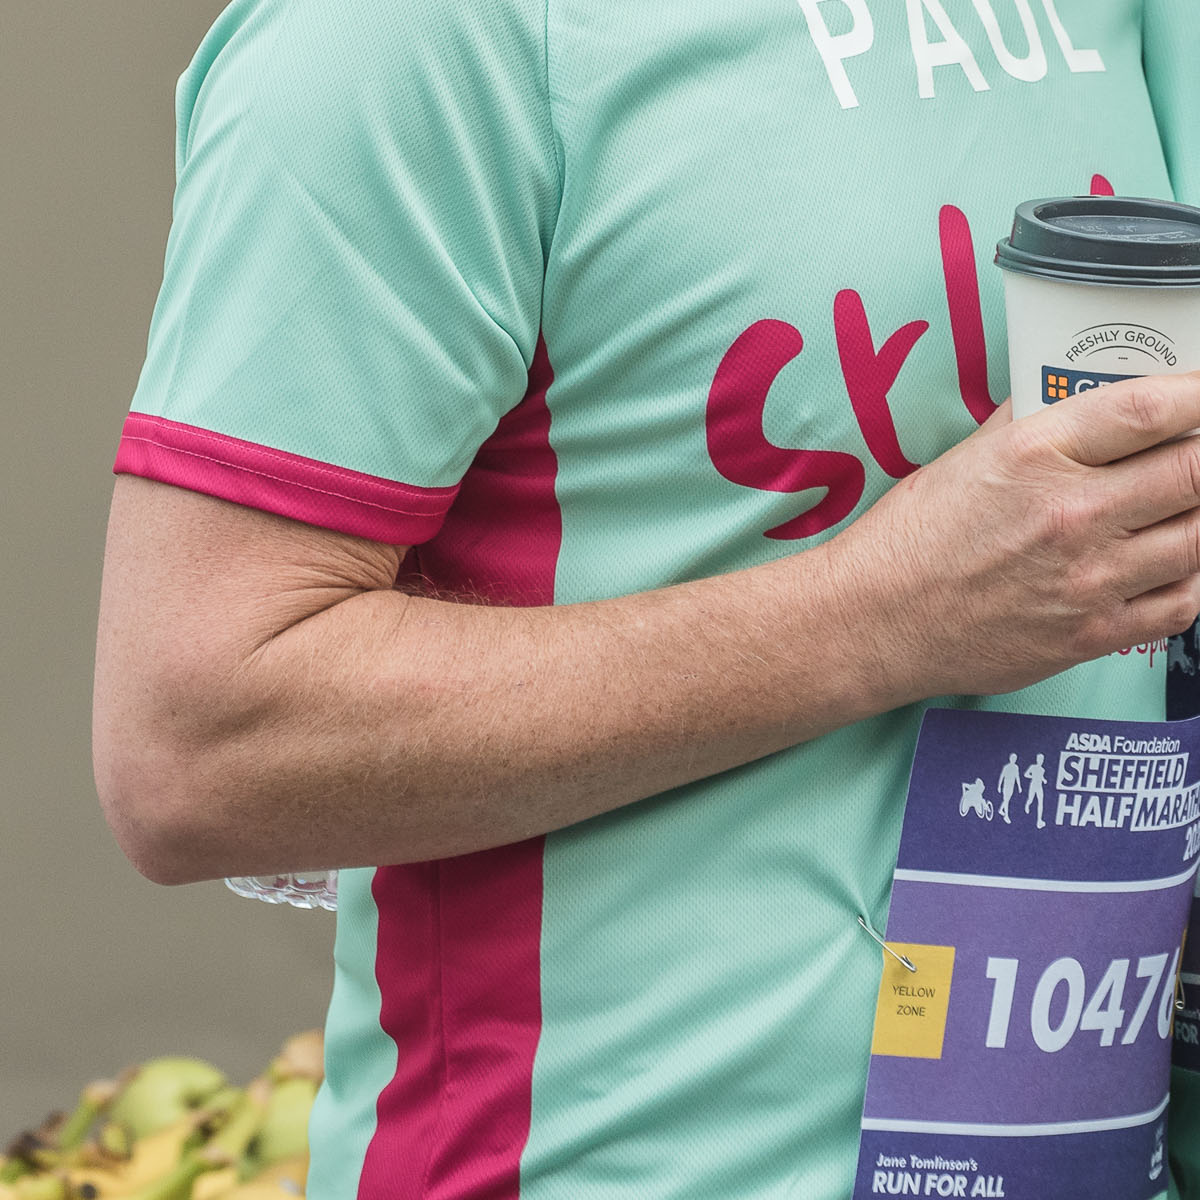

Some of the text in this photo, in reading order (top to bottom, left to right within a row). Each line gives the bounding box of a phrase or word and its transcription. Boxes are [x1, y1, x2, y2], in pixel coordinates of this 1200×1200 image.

[1065, 329, 1178, 367] FRESHLY GROUND
[1065, 732, 1181, 755] ASDA Foundation
[1060, 754, 1186, 789] SHEFFIELD
[1055, 793, 1135, 829] HALF
[892, 984, 936, 999] YELLOW
[896, 1004, 926, 1017] ZONE
[876, 1152, 979, 1172] Jane Tomlinson's
[872, 1169, 1005, 1199] RUN FOR ALL
